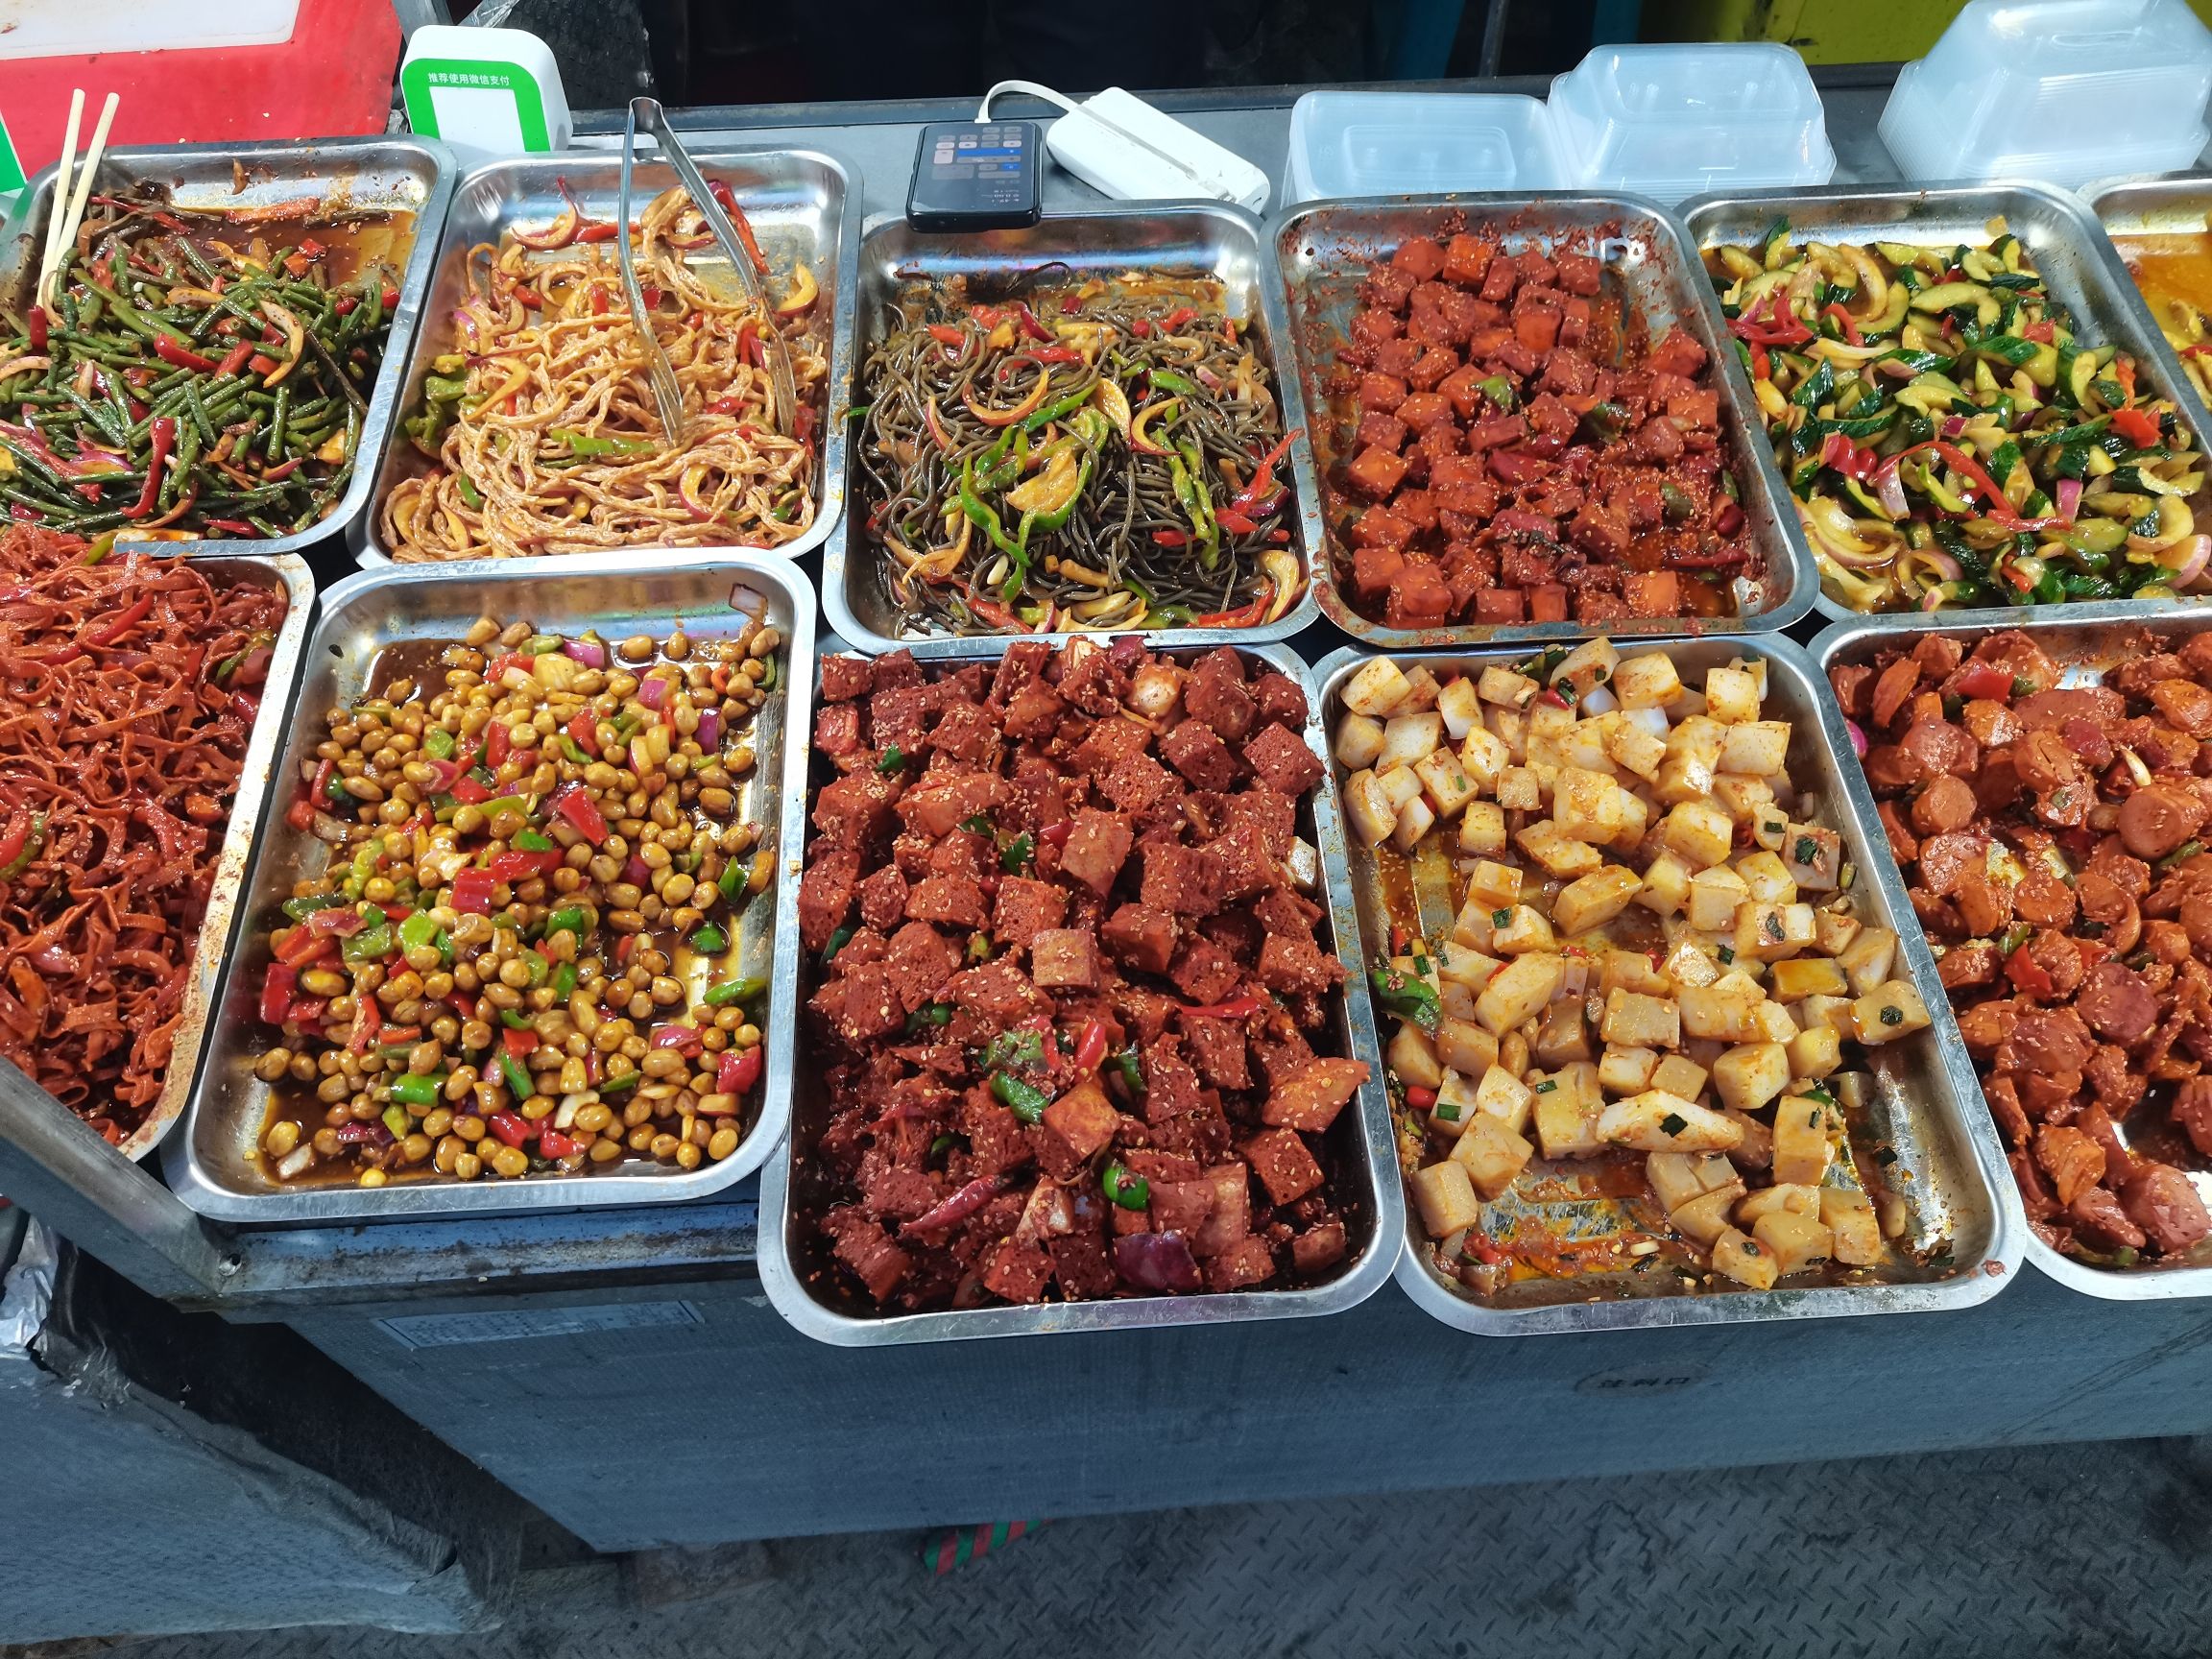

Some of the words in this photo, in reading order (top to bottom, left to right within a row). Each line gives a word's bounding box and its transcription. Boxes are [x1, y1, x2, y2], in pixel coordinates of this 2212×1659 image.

[427, 72, 510, 86] 推荐使用微信支付
